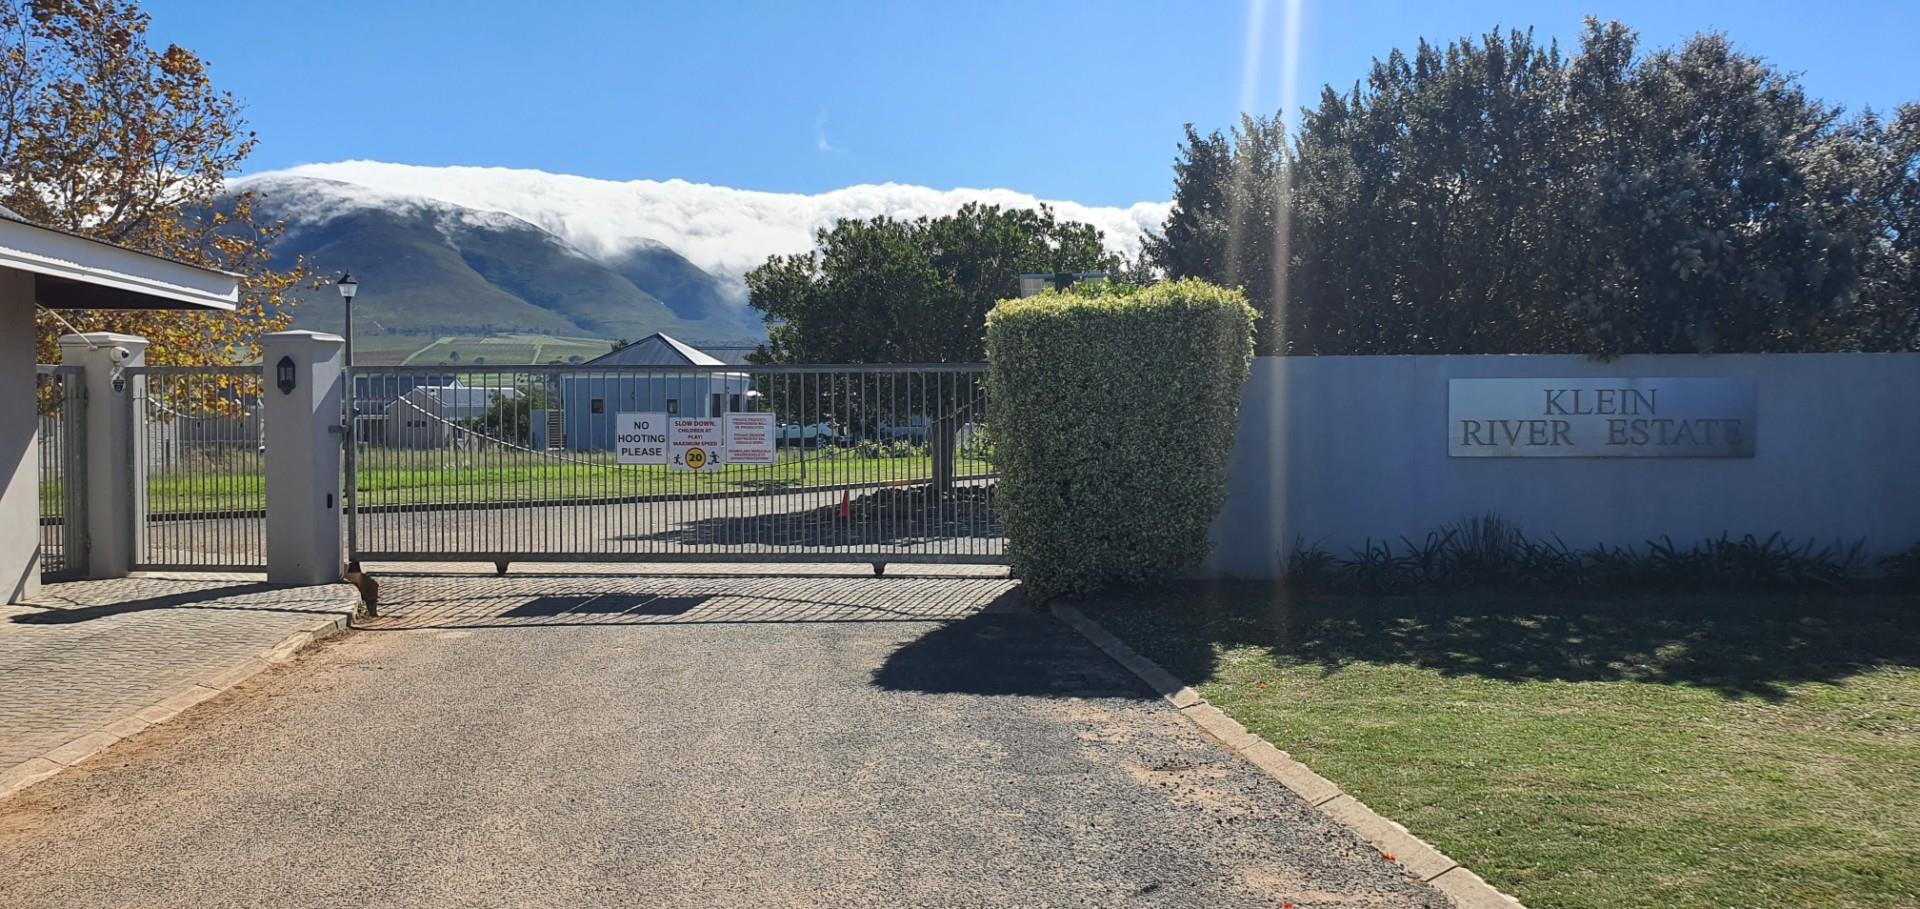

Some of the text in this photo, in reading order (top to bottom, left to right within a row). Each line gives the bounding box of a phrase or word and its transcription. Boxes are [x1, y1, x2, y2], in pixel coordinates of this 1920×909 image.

[1543, 389, 1658, 416] KLEIN
[633, 421, 650, 430] NO
[1461, 418, 1744, 446] RIVER ESTATE
[617, 434, 666, 443] HOOTING
[621, 447, 662, 456] PLEASE
[688, 453, 703, 462] 20
